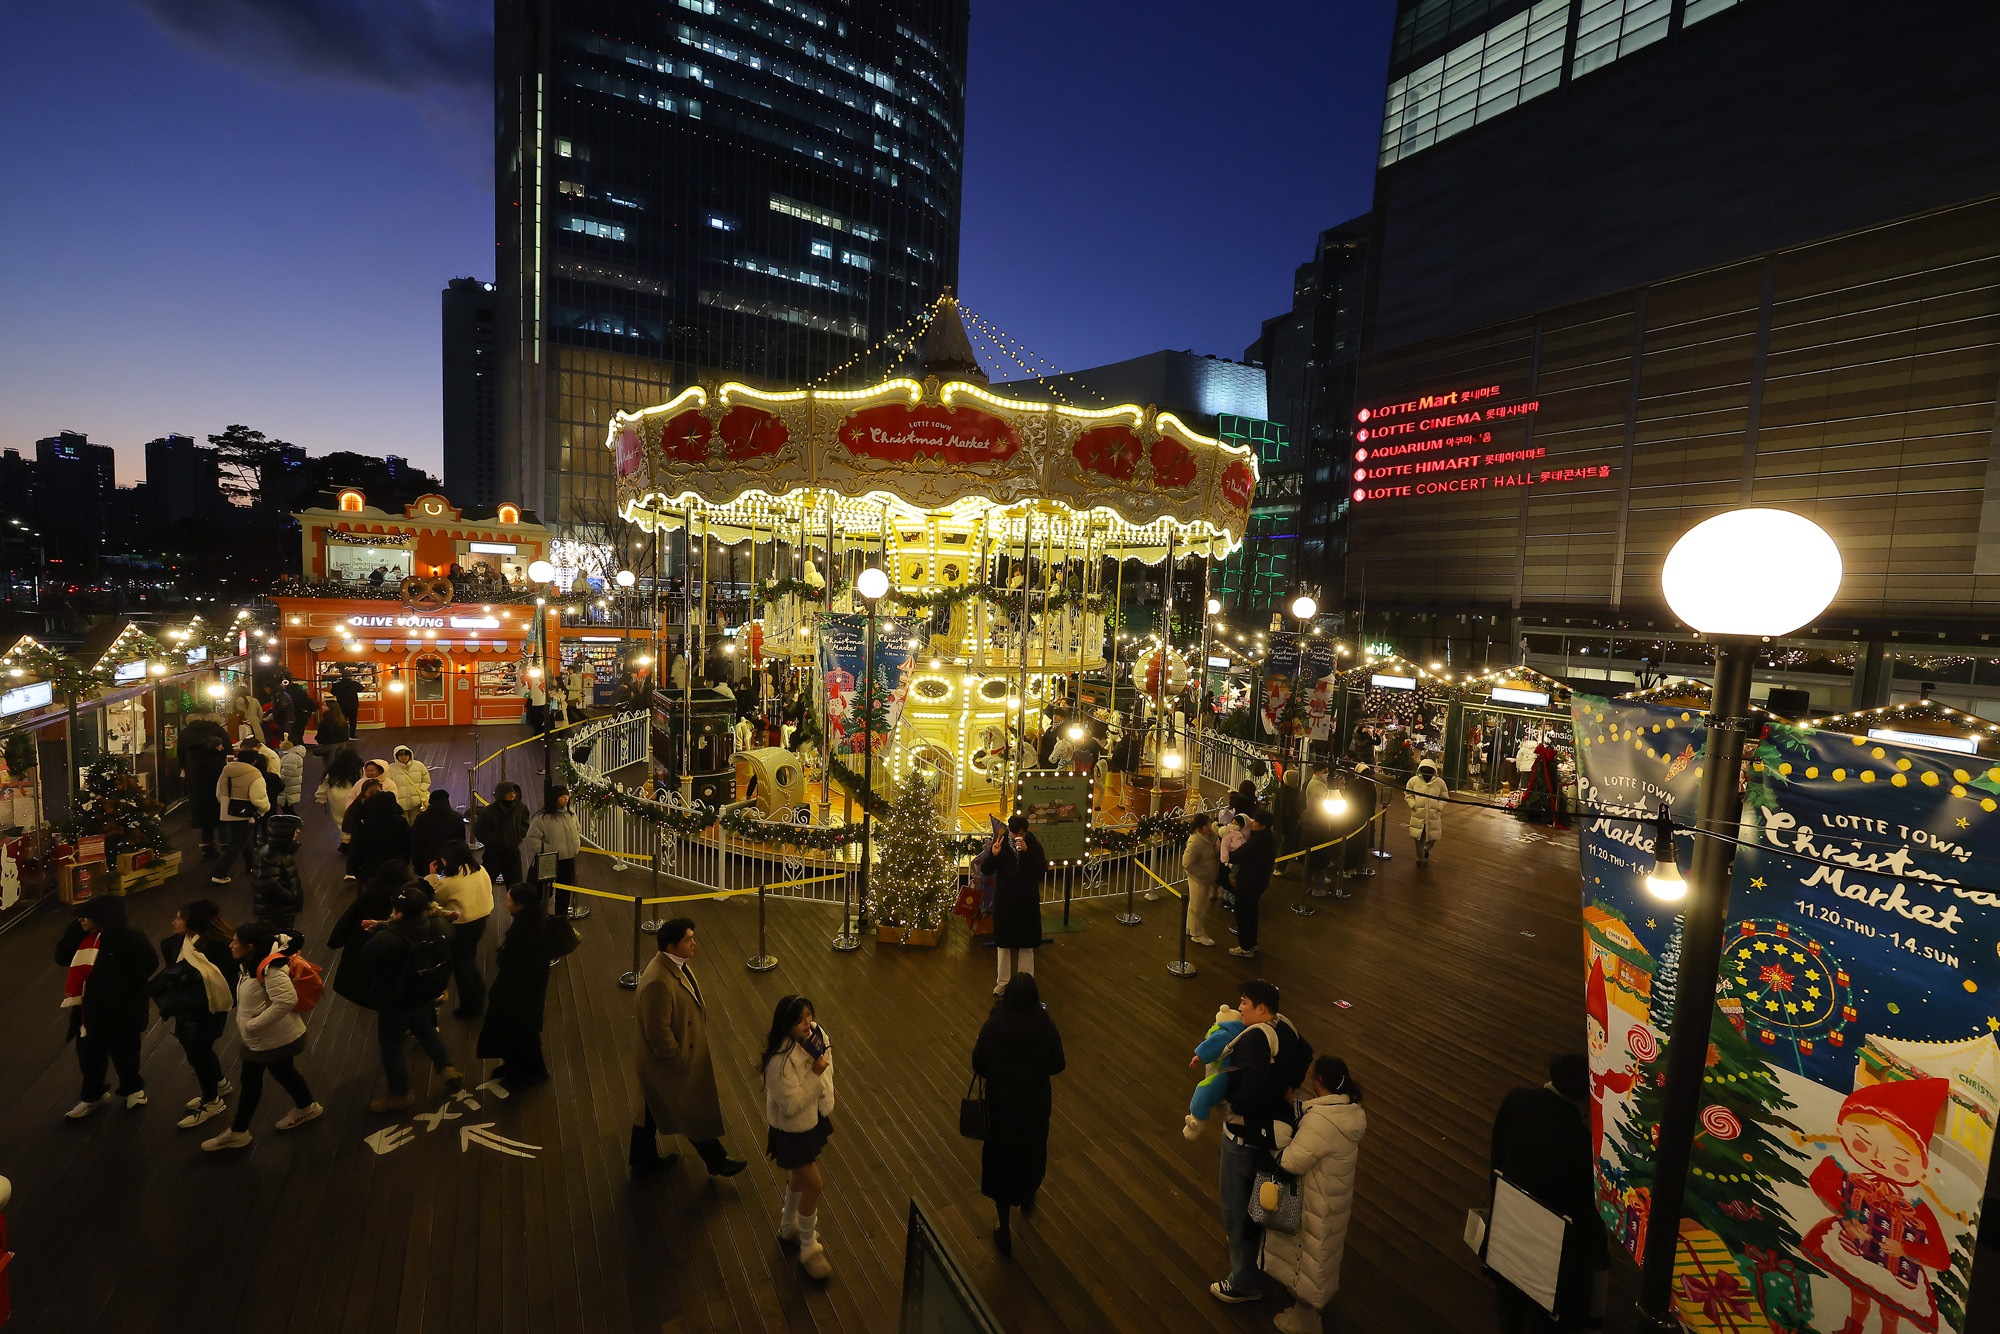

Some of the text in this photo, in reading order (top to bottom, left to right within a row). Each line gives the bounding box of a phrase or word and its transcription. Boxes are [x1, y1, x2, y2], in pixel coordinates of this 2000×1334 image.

[1371, 401, 1540, 438] LOTTE CINEMA 롯데시네마
[1373, 401, 1417, 418] LOTTE
[1418, 391, 1458, 410] Mart
[869, 426, 991, 450] Christmas Market
[908, 420, 952, 430] LOTTE TOWN
[1368, 447, 1547, 479] LOTTE HIMART 롯데하이마트
[1370, 439, 1443, 459] AQUARIUM
[1368, 465, 1611, 499] LOTTE CONCERT HALL 롯데콘서트홀
[352, 616, 444, 628] OLIVE YOUNG
[1603, 776, 1676, 805] LOTTE TOWN
[1590, 813, 1656, 854] Marke
[1821, 813, 1973, 863] LOTTE TOWN
[1799, 865, 1964, 935] Market
